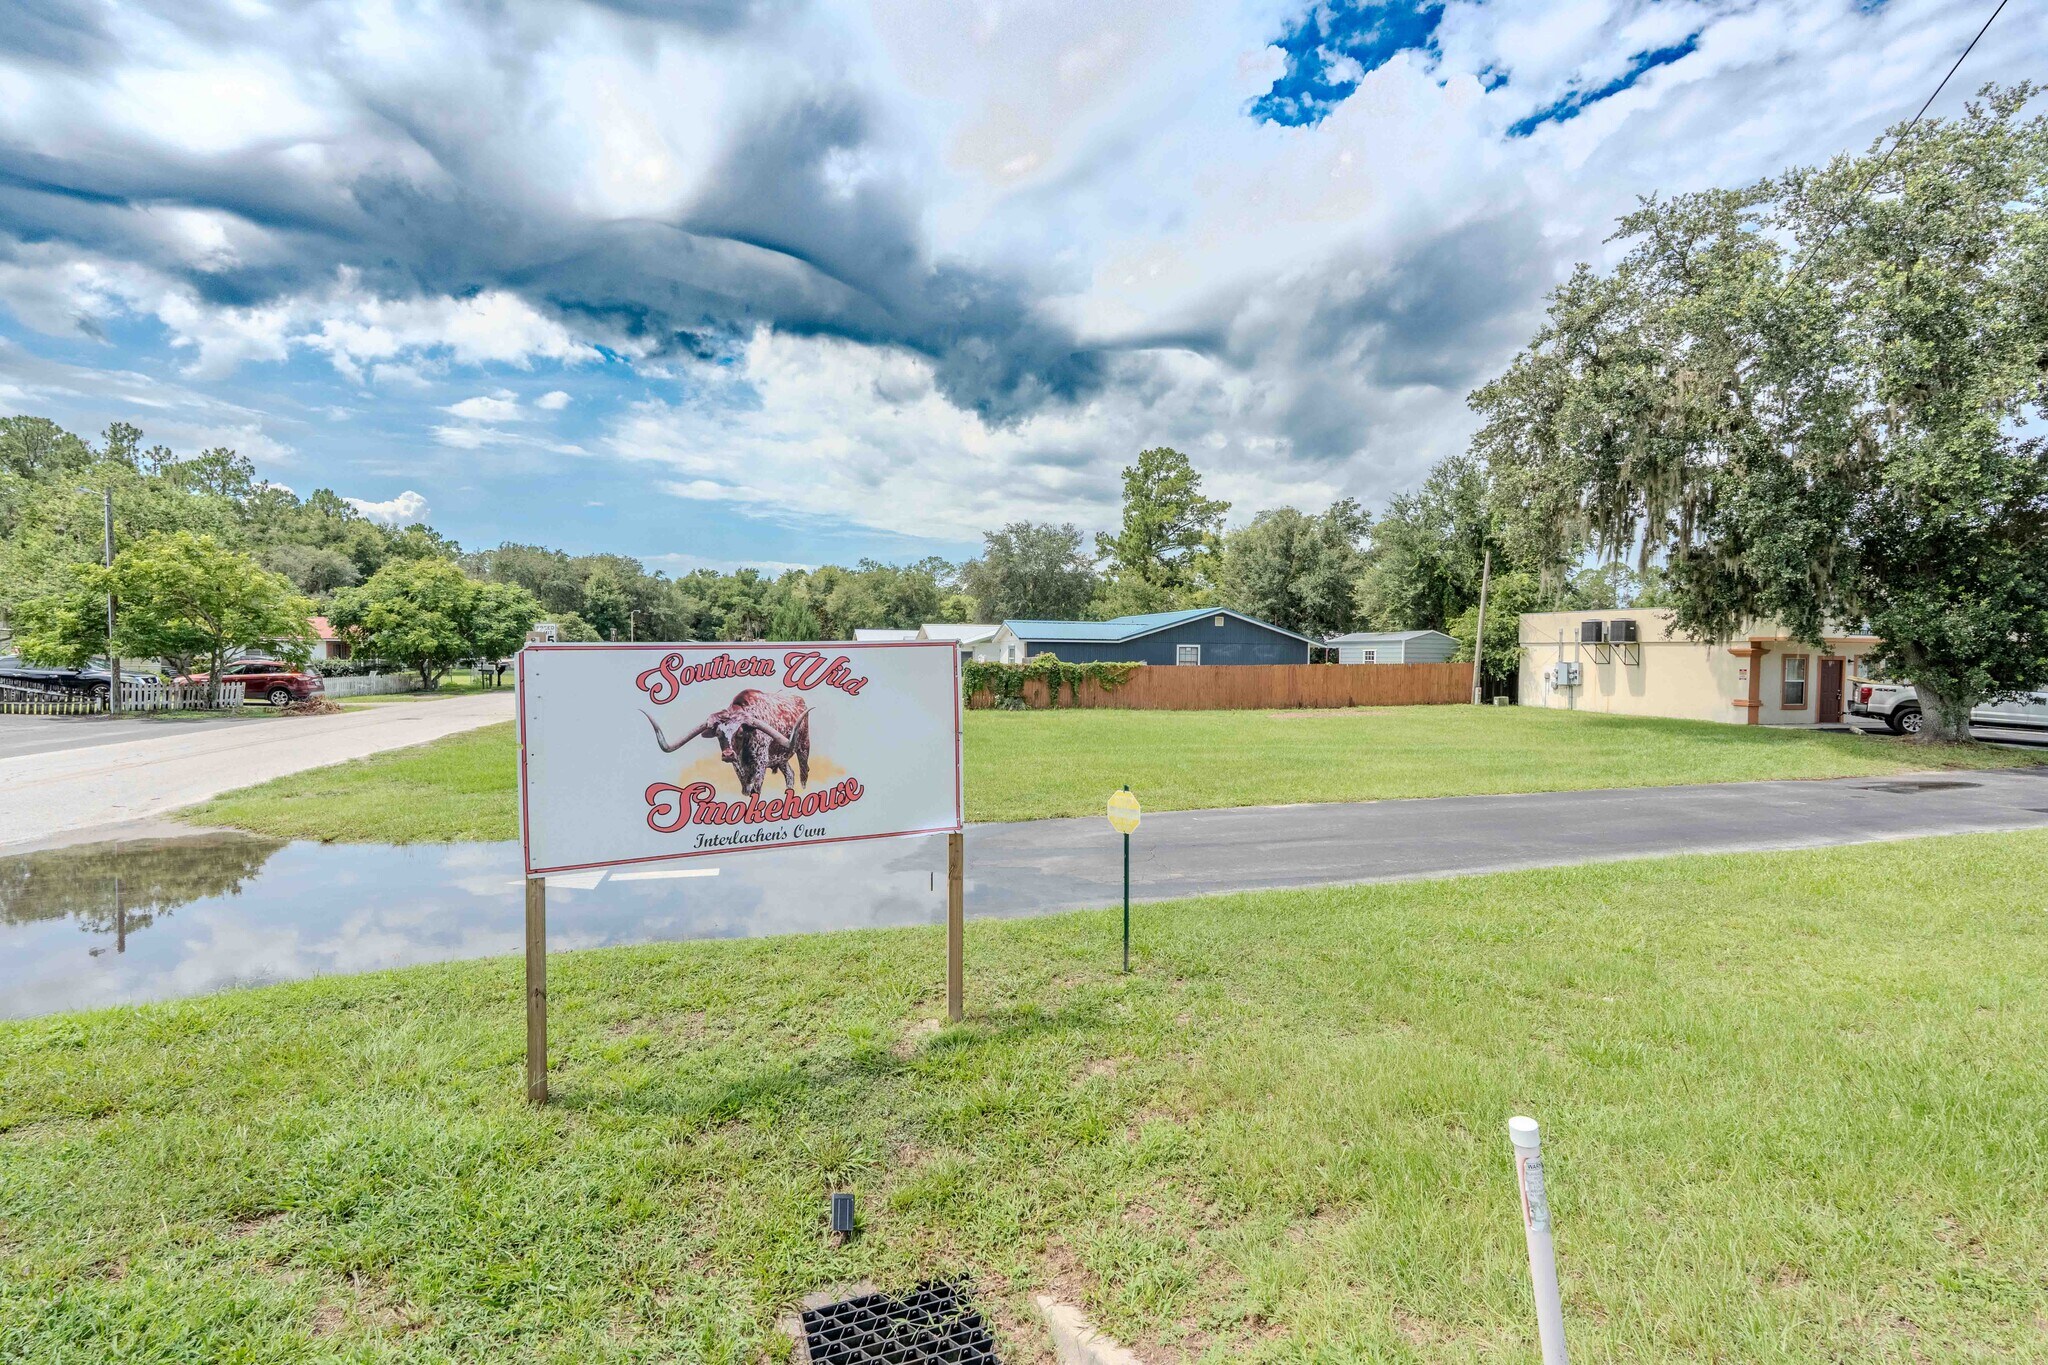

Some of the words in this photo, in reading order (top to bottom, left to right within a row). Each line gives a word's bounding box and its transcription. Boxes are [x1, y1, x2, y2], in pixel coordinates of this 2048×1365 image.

[636, 652, 775, 705] Southern
[783, 651, 868, 696] Wild
[645, 777, 864, 833] Smokehouse
[693, 826, 788, 848] Interlachen's
[793, 824, 826, 839] Own
